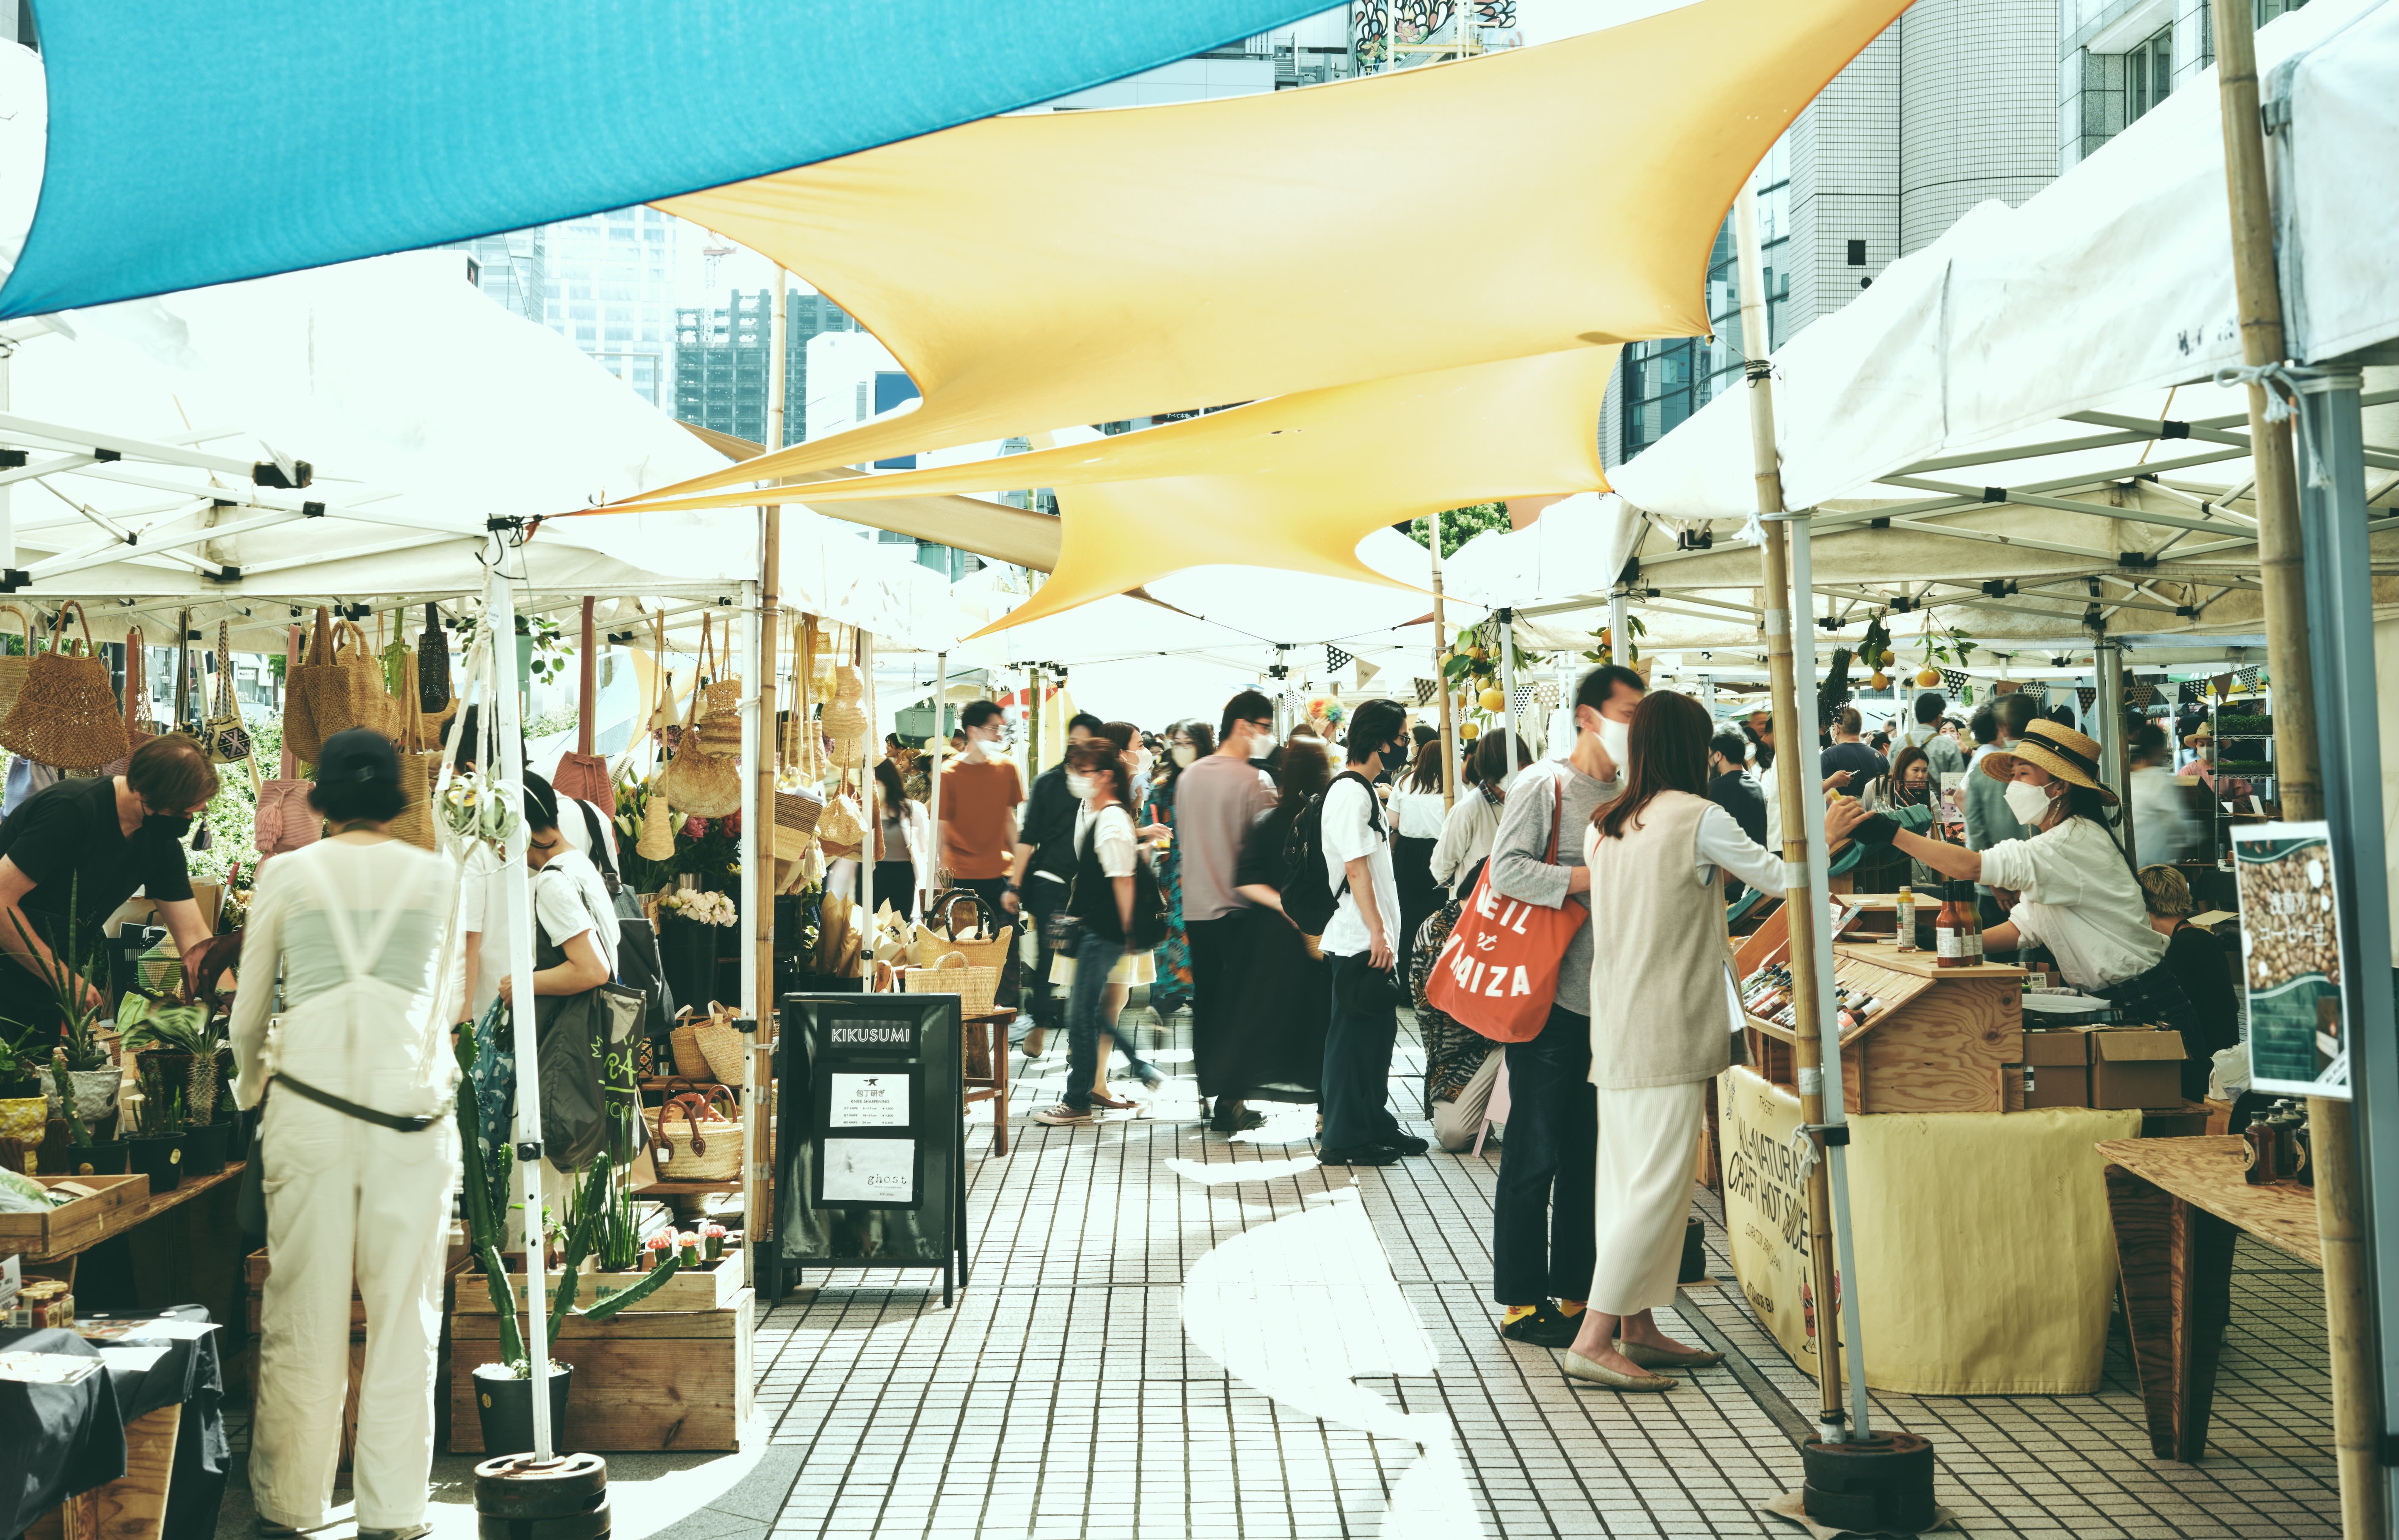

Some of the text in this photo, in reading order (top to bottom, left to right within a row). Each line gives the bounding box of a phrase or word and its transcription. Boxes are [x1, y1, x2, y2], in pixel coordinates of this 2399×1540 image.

[832, 1028, 909, 1042] KIKUSUMI
[868, 1174, 906, 1185] ghost
[1728, 1151, 1808, 1257] CRAFT HOT SAUCE
